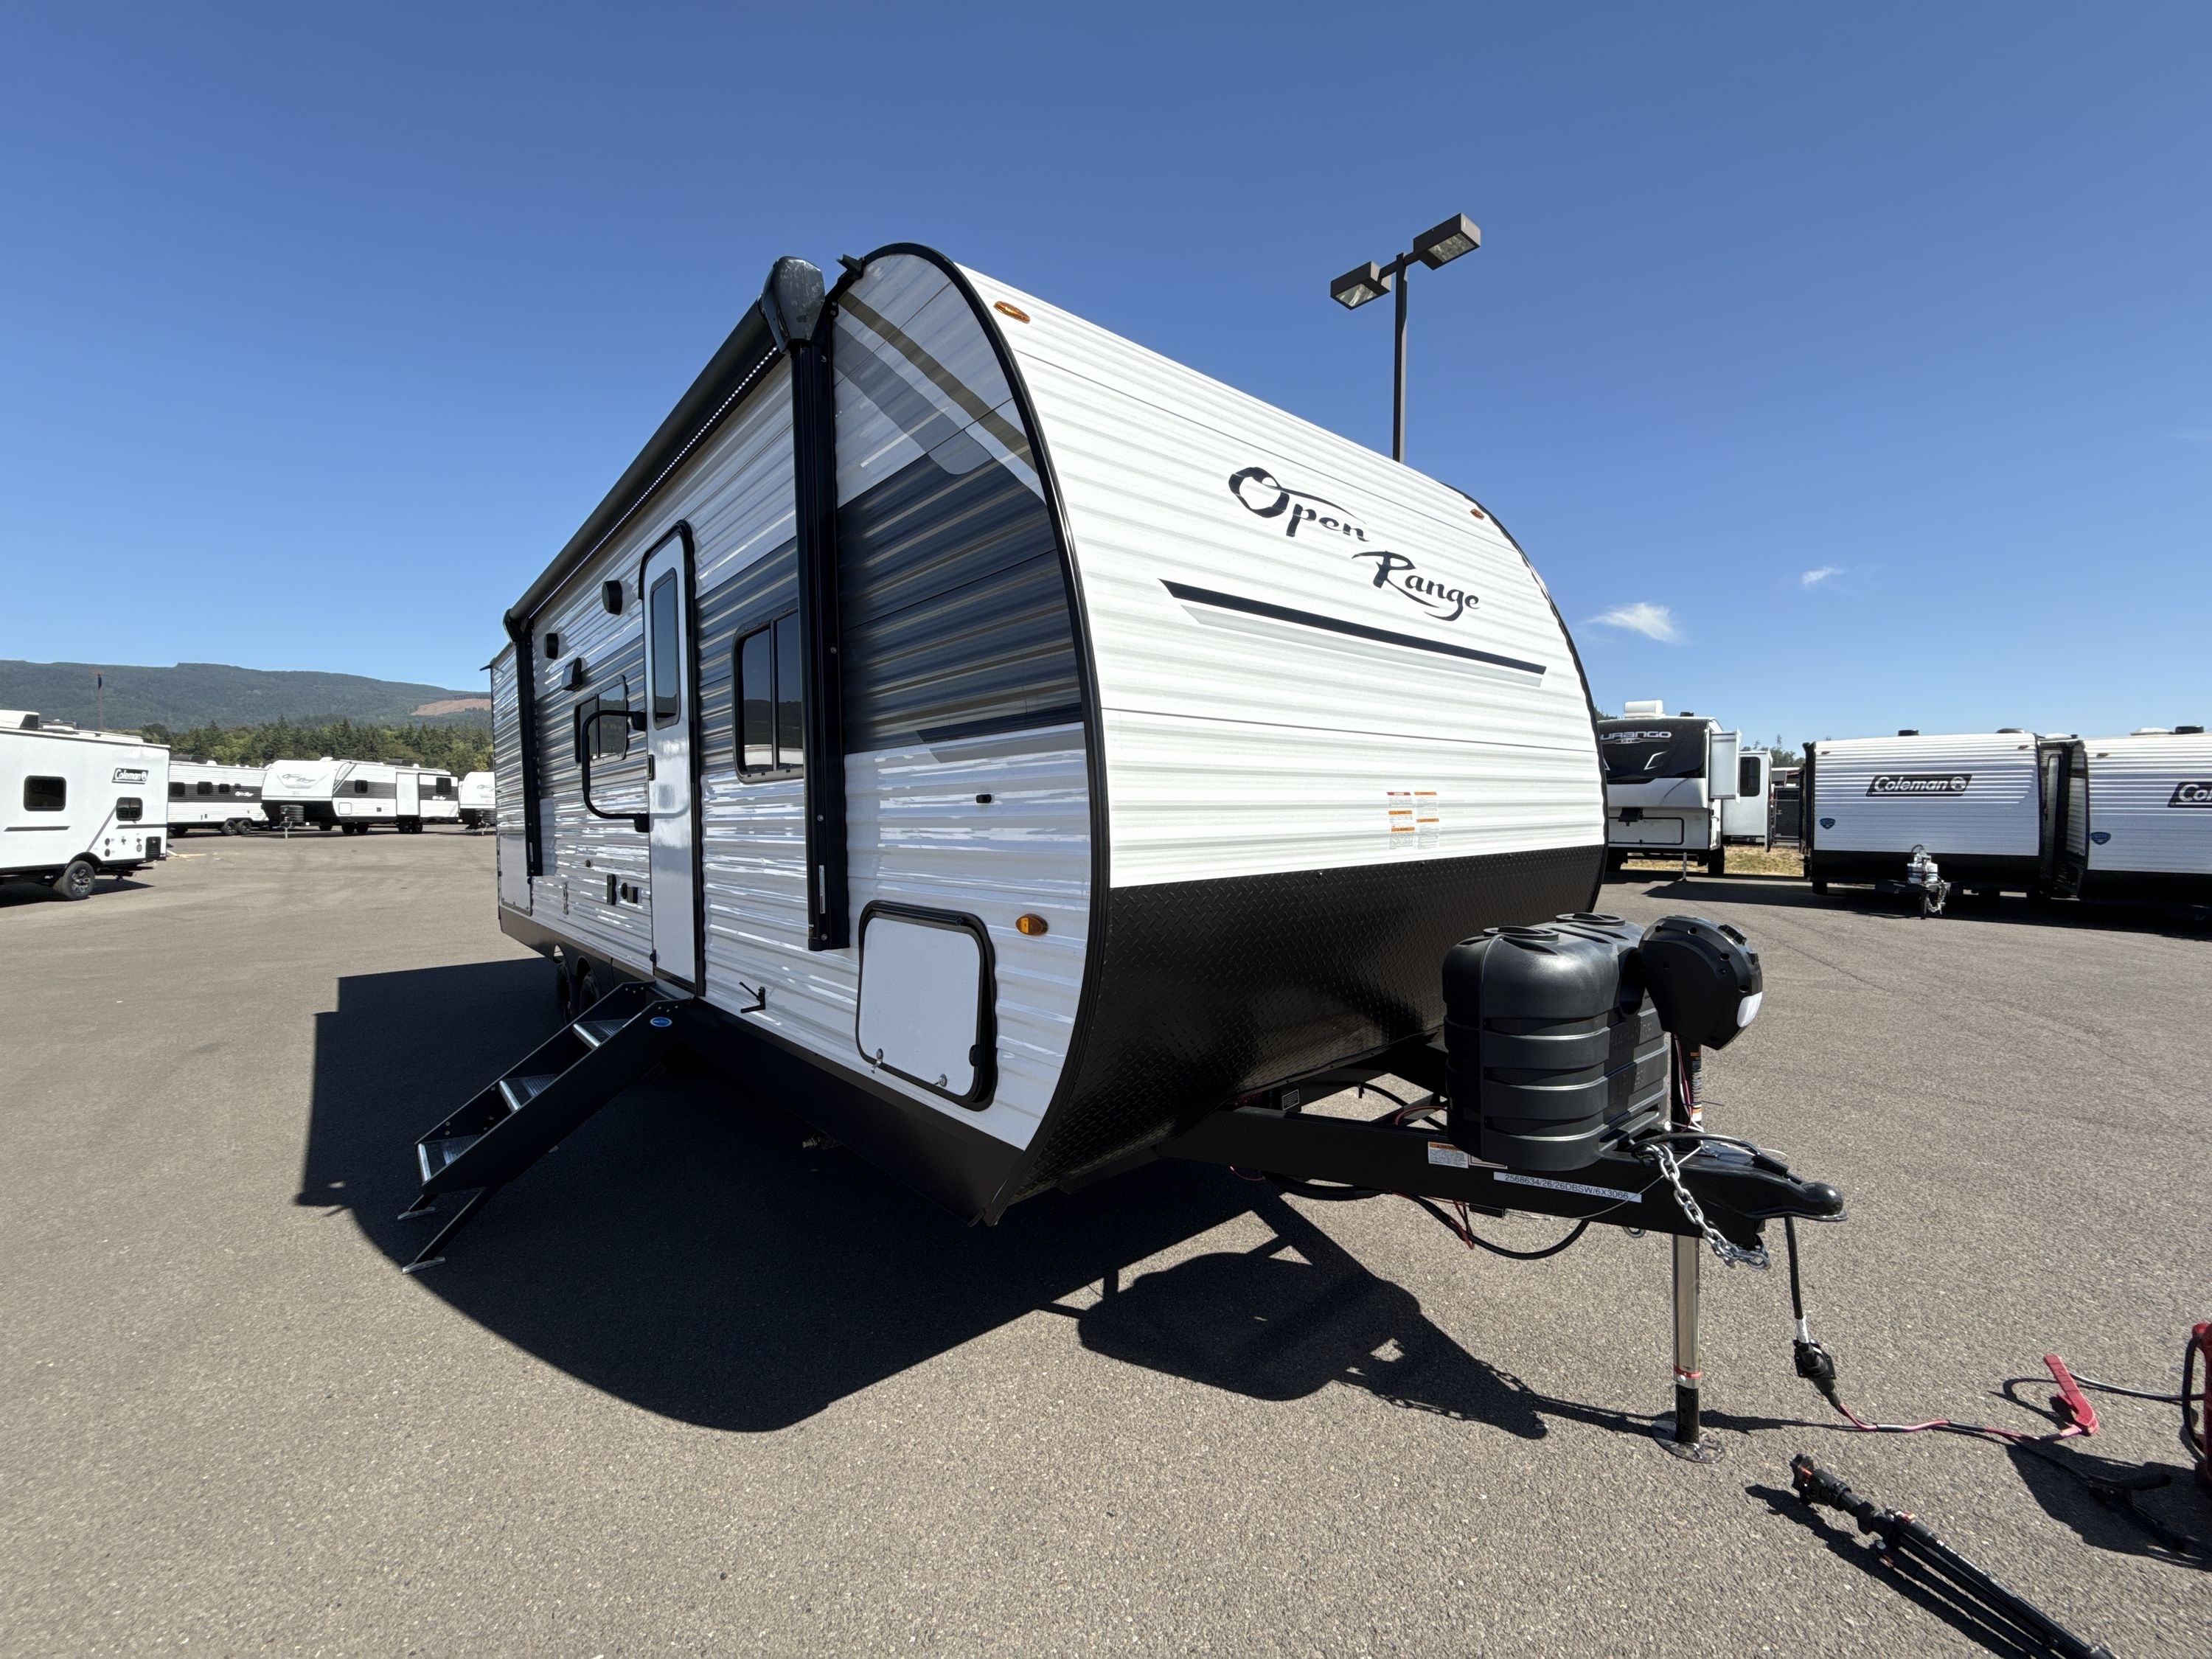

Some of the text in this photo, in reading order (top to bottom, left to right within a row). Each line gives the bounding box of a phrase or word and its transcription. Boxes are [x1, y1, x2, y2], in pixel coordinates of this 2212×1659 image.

[1228, 466, 1370, 542] Open
[1351, 550, 1480, 622] Range
[1600, 731, 1672, 740] URANGO
[114, 768, 142, 780] Coleman
[1874, 776, 1949, 792] Coleman
[1504, 1174, 1629, 1200] 2568634/26/26DBSW/6X3066
